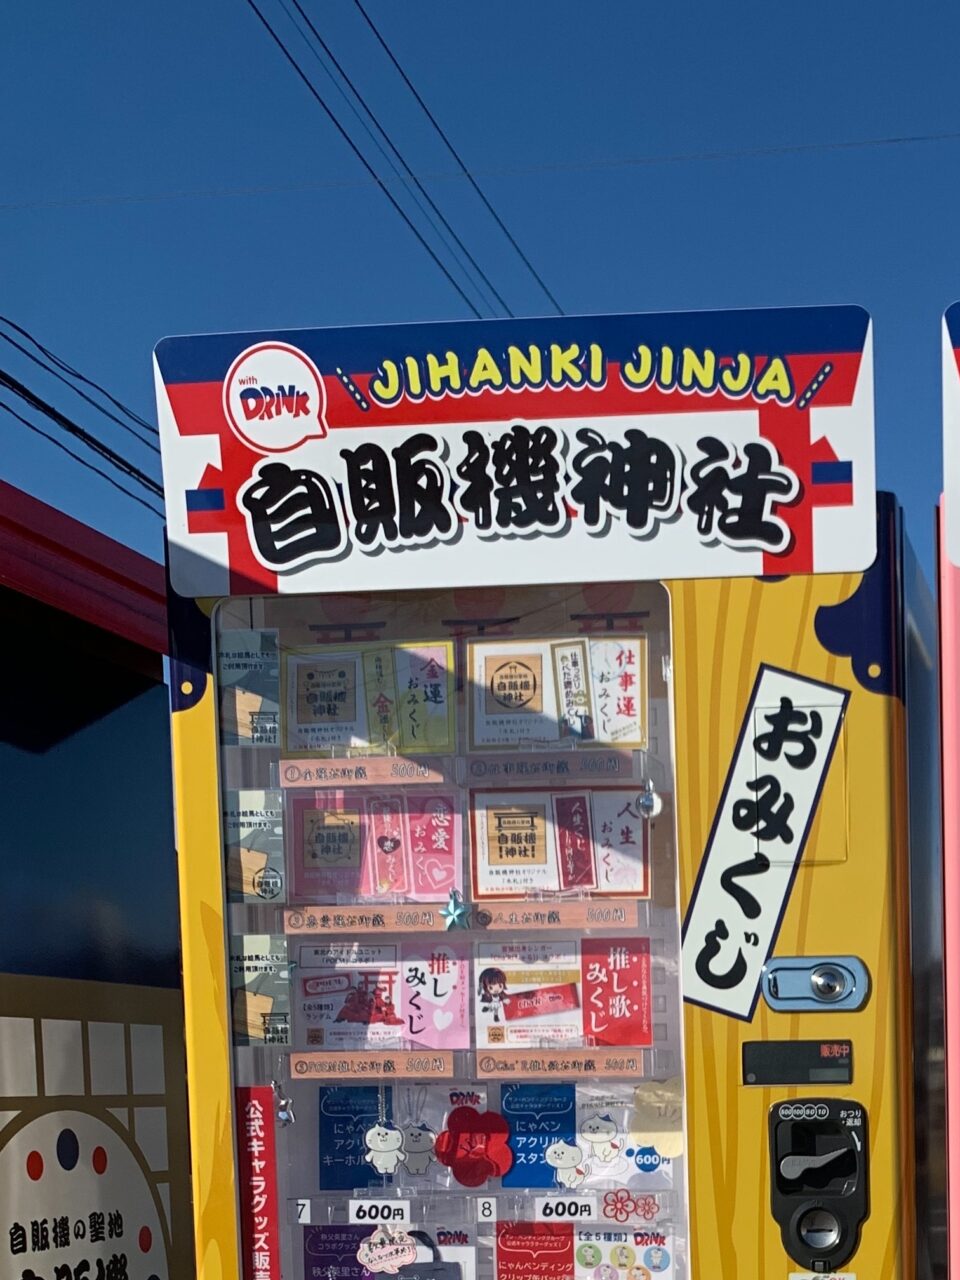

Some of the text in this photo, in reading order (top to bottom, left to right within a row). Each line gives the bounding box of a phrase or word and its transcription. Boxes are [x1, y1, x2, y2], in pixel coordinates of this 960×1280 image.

[237, 375, 258, 386] with
[371, 343, 795, 403] JIHANKI JINJA
[238, 386, 310, 422] DRINK
[243, 423, 792, 564] 自販機神社
[420, 658, 444, 704] 金運
[599, 671, 611, 733] おみくじ
[616, 650, 637, 717] 仕事運
[408, 677, 419, 738] おみくじ
[431, 805, 451, 851] 恋愛
[498, 833, 536, 844] 自販機
[617, 802, 639, 845] 人生
[696, 696, 823, 989] おみくじ
[415, 825, 427, 886] おみくじ
[601, 821, 614, 883] おみくじ
[428, 953, 450, 998] 推し
[587, 963, 609, 1032] みくじ
[609, 947, 630, 1018] 推し歌
[406, 967, 427, 1035] みくじ
[840, 1110, 862, 1118] おつり
[637, 1154, 670, 1165] 600円
[9, 1209, 124, 1256] 自販機の聖地
[296, 1204, 306, 1218] 7
[356, 1205, 404, 1220] 600円
[481, 1202, 492, 1217] 8
[542, 1202, 591, 1217] 600円
